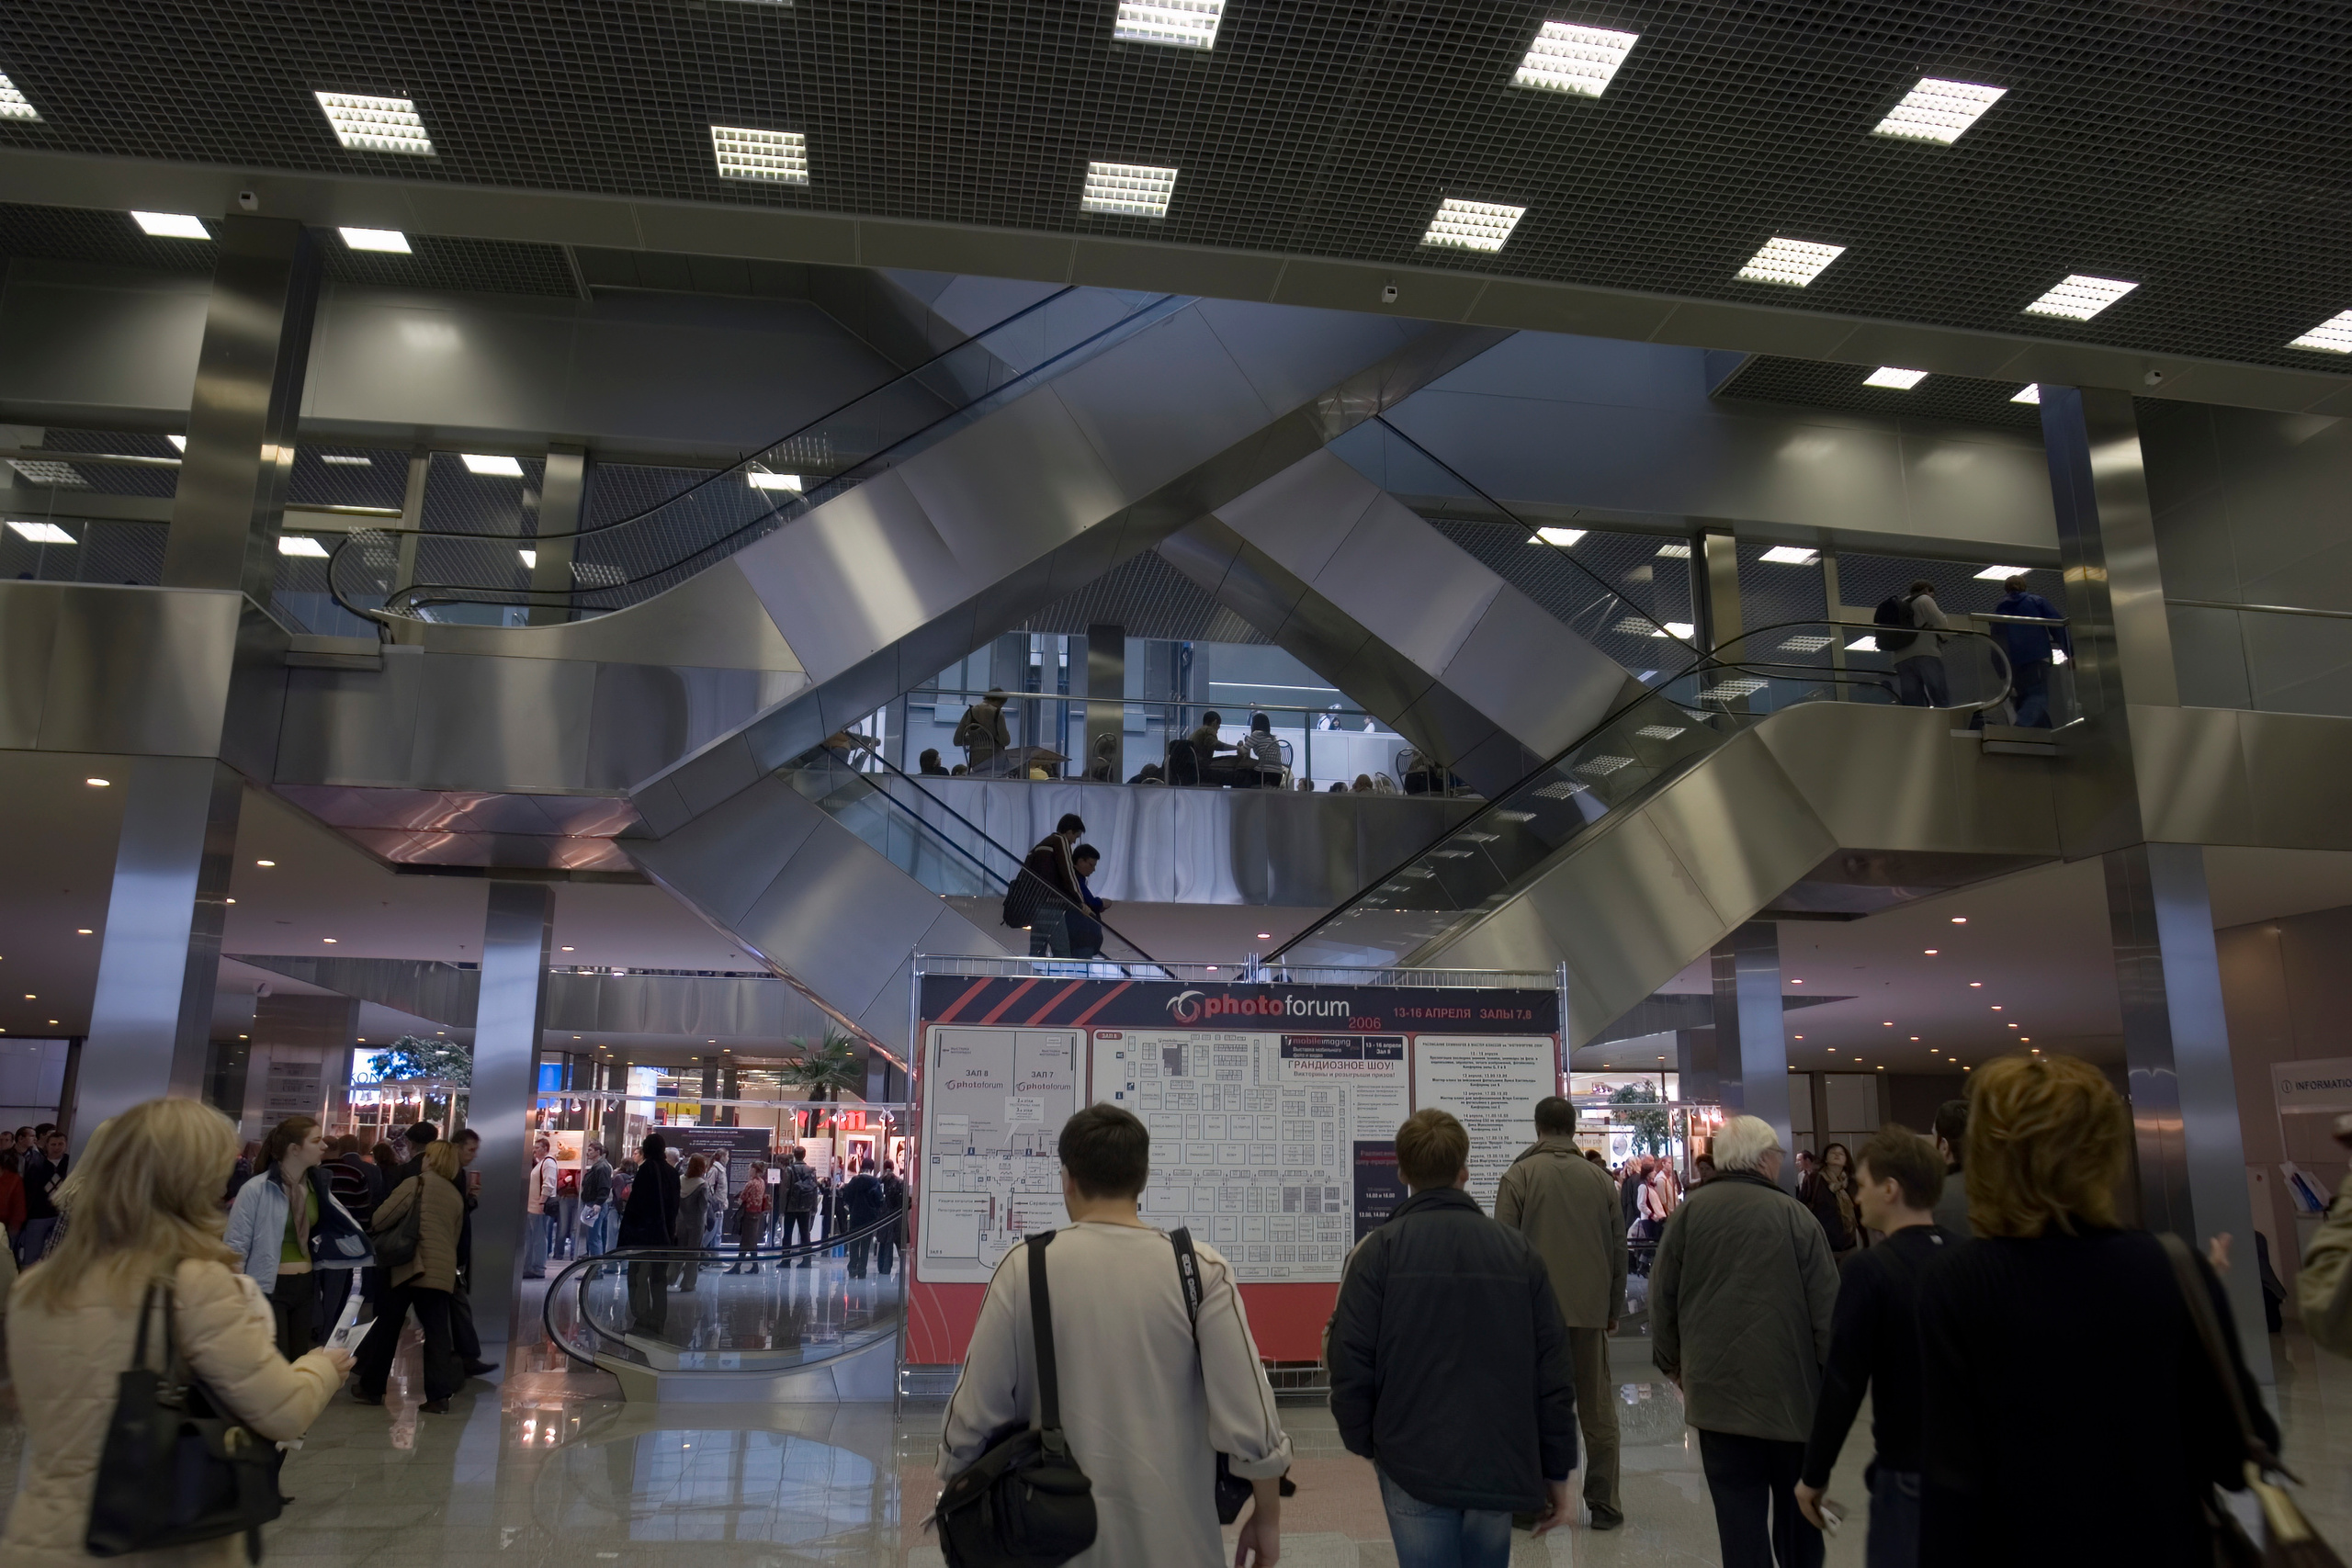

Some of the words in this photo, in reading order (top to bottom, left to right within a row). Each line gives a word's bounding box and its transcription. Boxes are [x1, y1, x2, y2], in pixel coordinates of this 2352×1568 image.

[1204, 994, 1350, 1019] photoforum
[1394, 1008, 1423, 1019] 13-16
[1425, 1008, 1471, 1019] АПРЕЛЯ
[1479, 1009, 1515, 1020] ЗАЛЫ
[1349, 1017, 1382, 1029] 2006
[1292, 1037, 1351, 1047] mobileimaging
[1288, 1060, 1364, 1071] ГРАНДИОЗНОЕ
[1368, 1061, 1395, 1071] ШОУ!
[956, 1080, 1003, 1089] photoforum
[1026, 1081, 1071, 1091] photoforum
